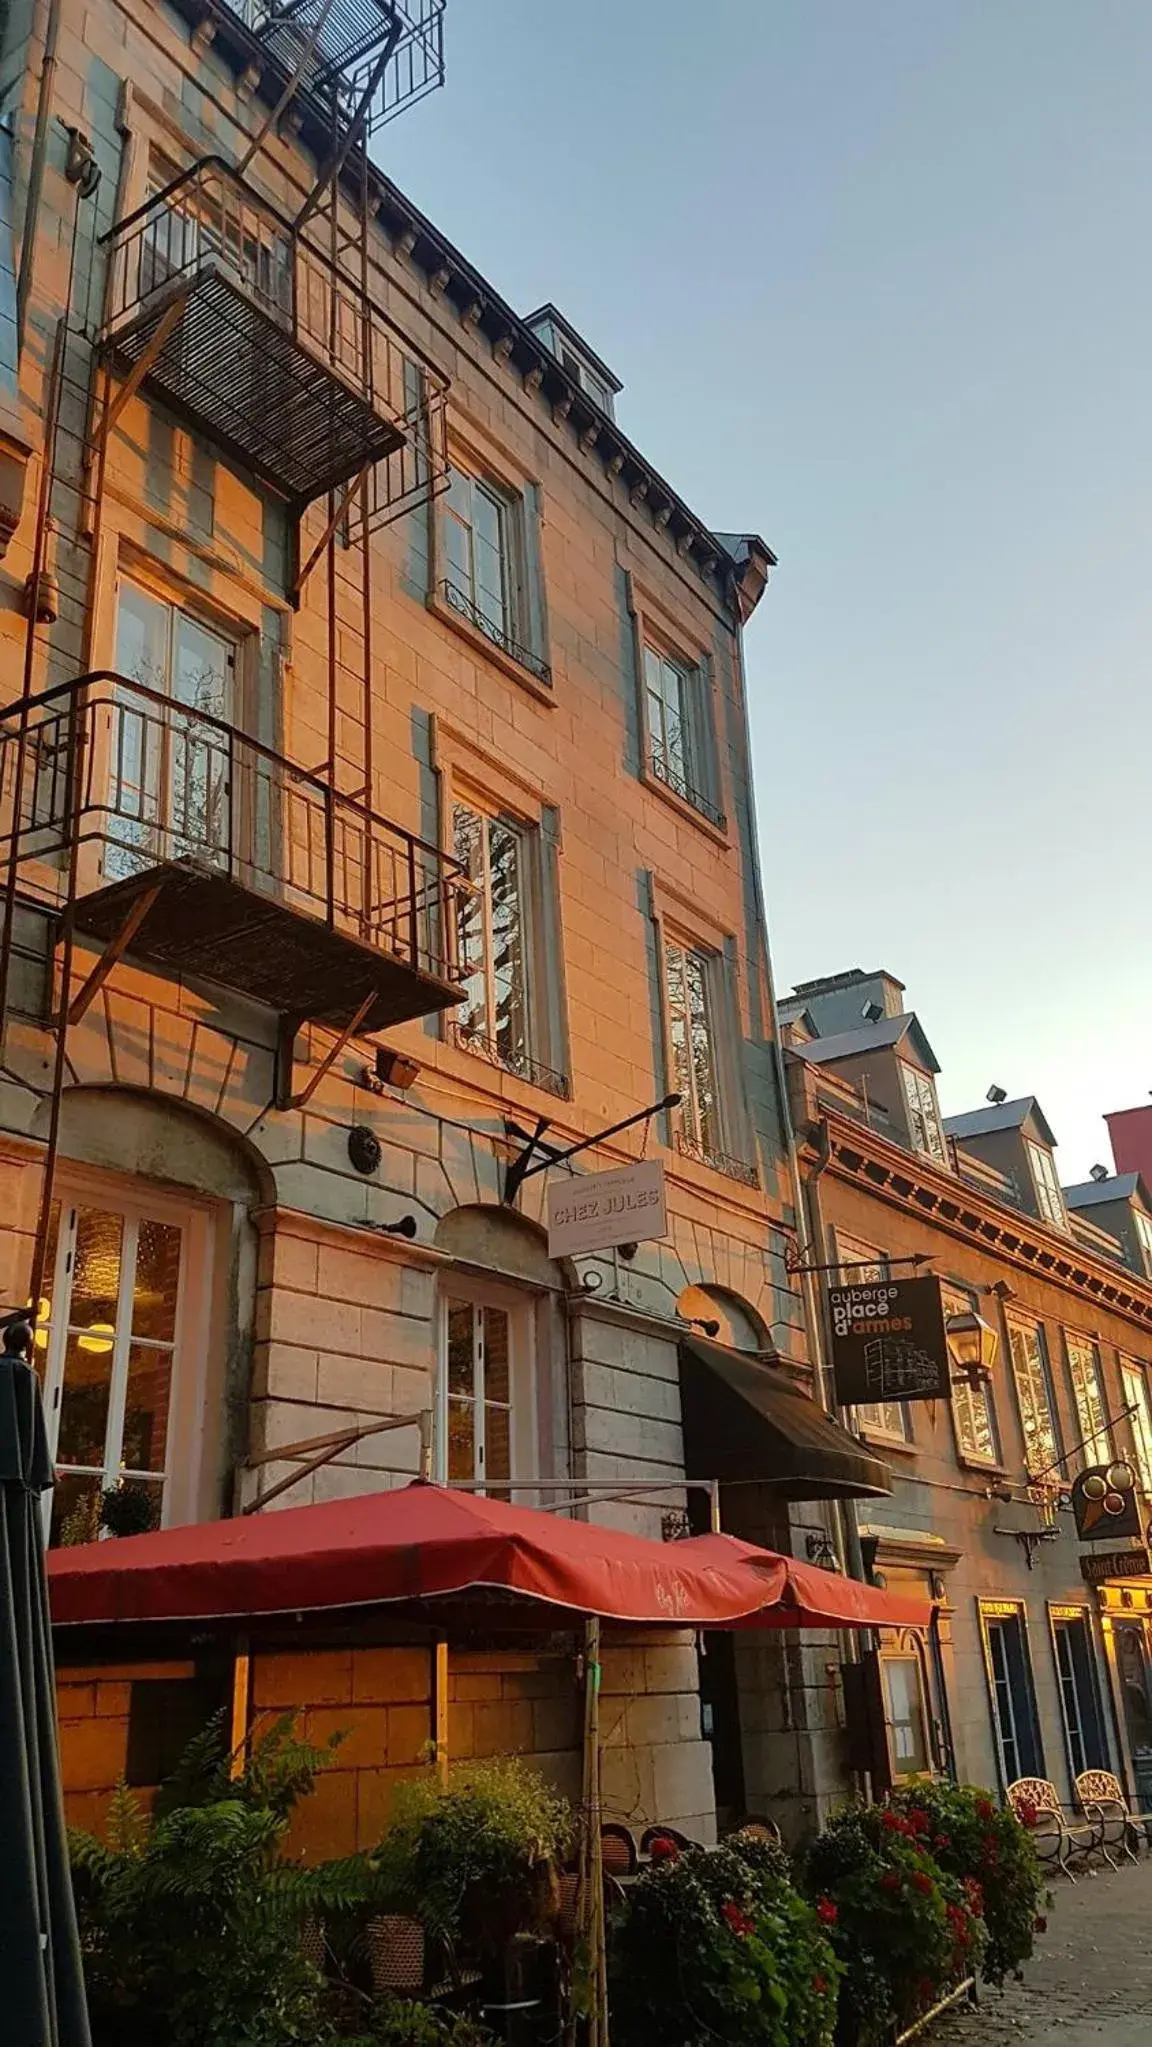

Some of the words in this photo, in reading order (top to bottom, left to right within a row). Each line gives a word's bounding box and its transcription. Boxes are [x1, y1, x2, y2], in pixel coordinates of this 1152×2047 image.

[554, 1201, 599, 1225] CHEZ
[603, 1188, 660, 1215] JULES
[830, 1287, 898, 1304] auberge
[833, 1301, 890, 1323] place
